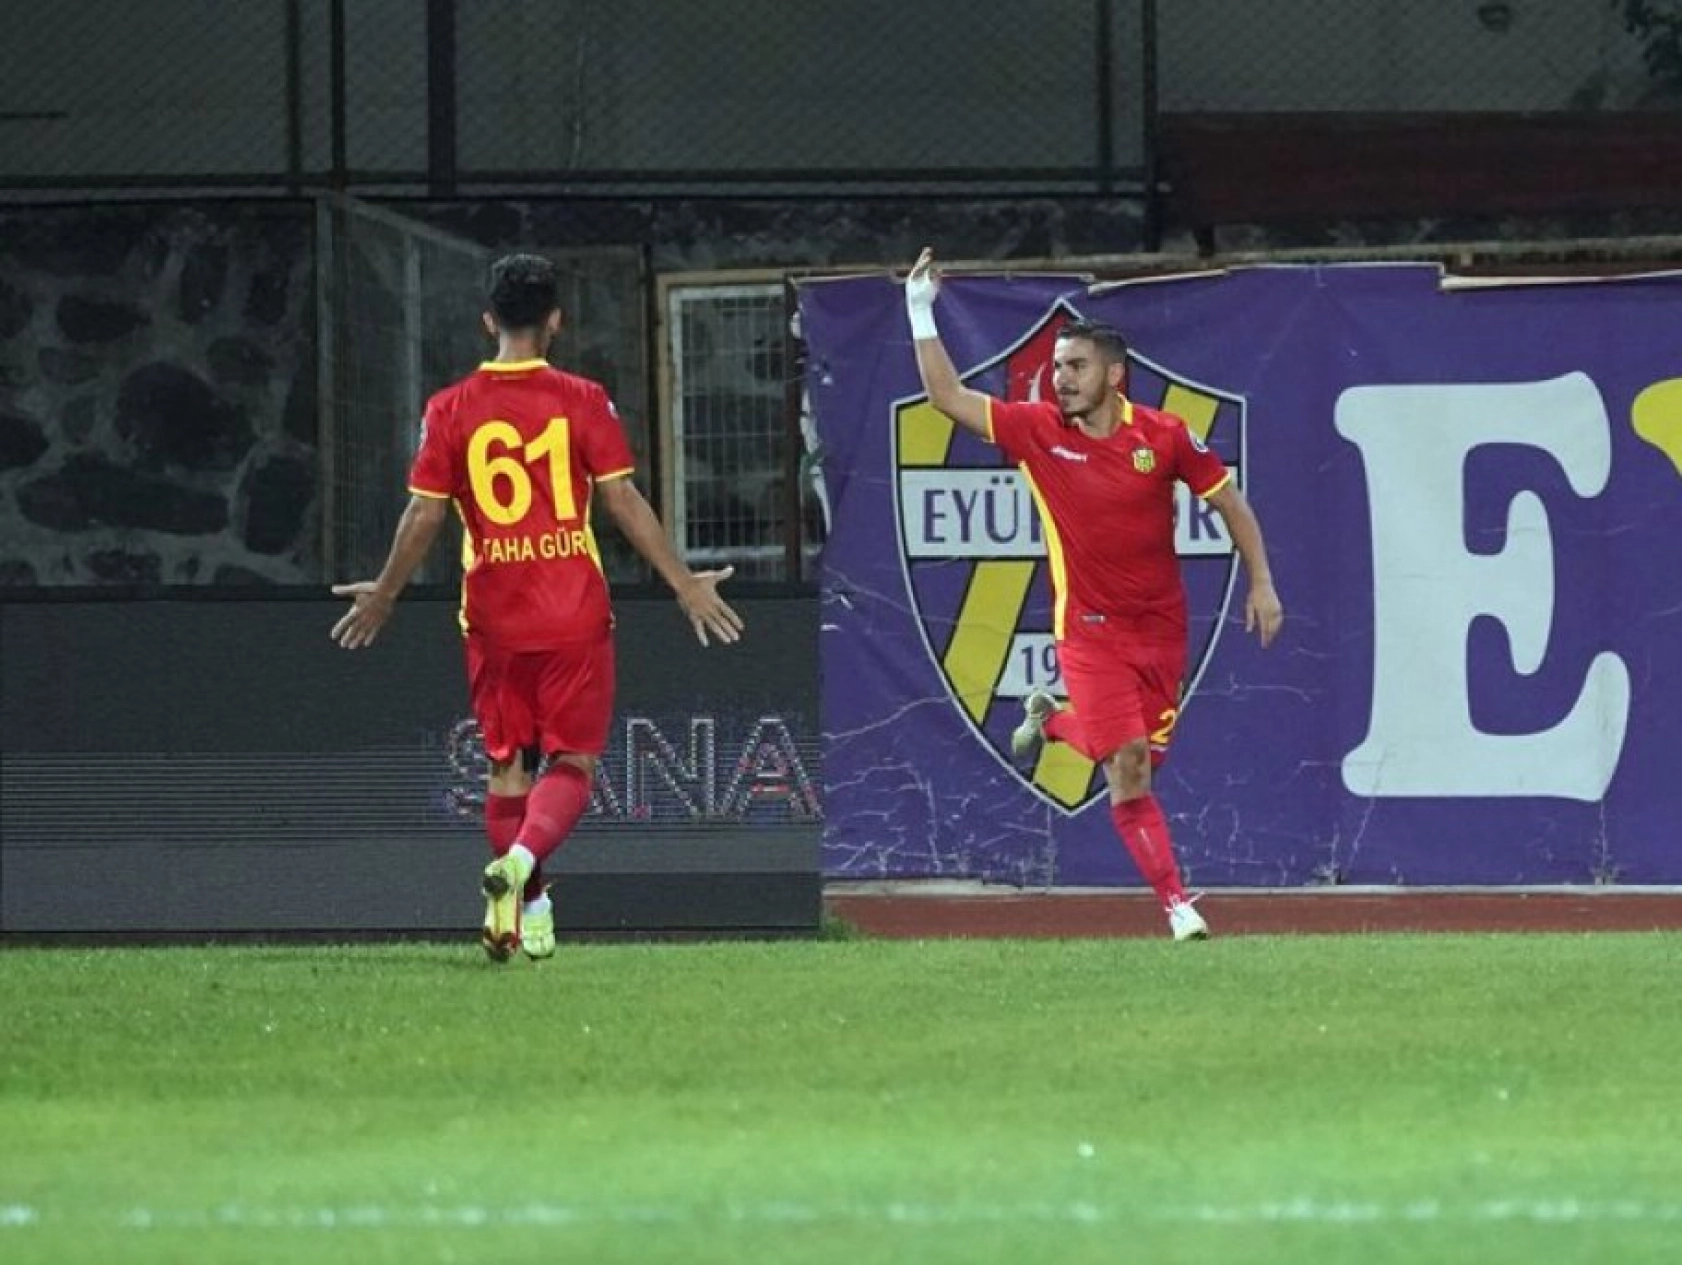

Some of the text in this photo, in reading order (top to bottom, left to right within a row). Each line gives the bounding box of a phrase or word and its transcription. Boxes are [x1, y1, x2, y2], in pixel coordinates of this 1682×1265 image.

[468, 418, 577, 526] 61
[481, 535, 536, 563] TAHA
[1334, 370, 1682, 803] E
[1021, 643, 1061, 686] 19
